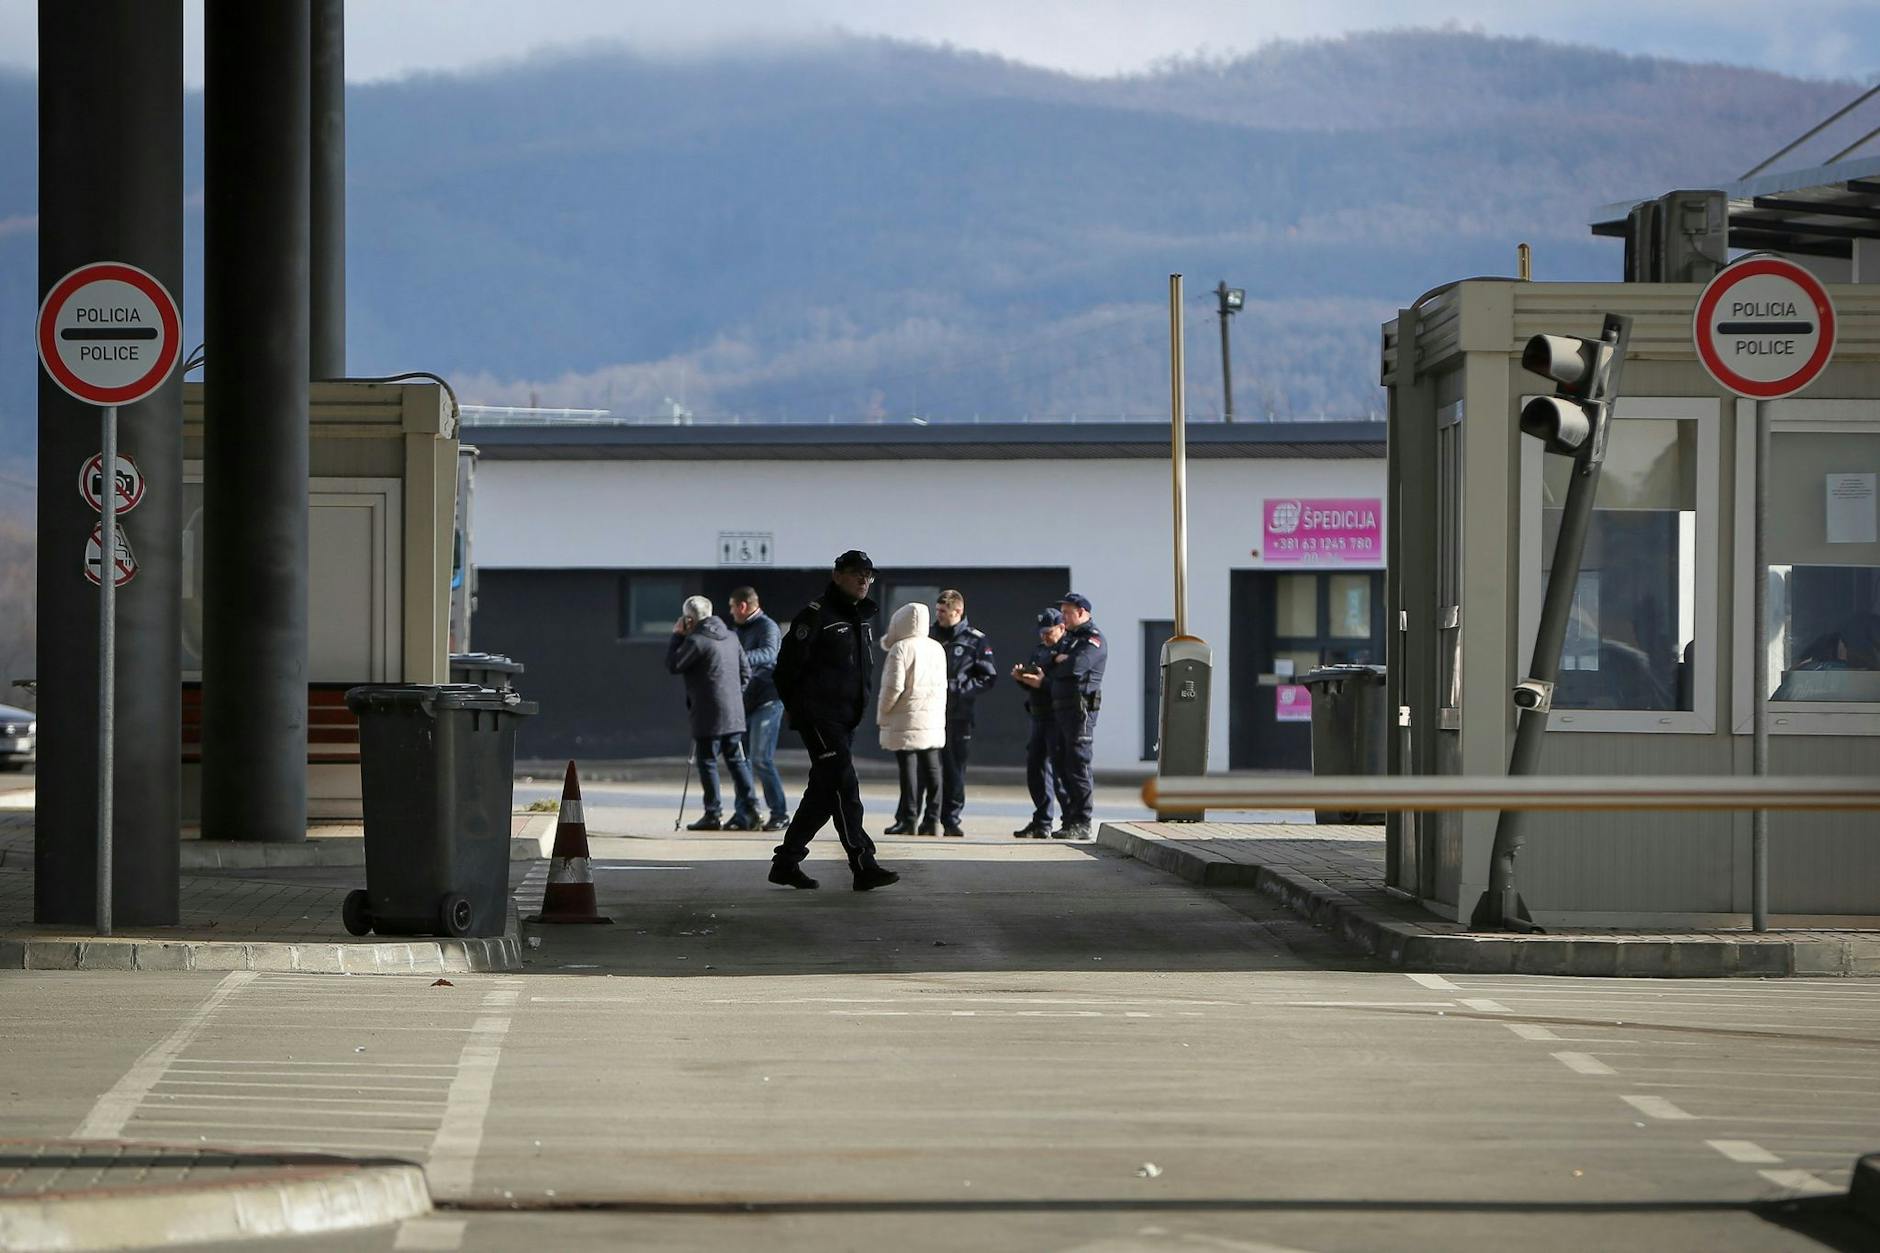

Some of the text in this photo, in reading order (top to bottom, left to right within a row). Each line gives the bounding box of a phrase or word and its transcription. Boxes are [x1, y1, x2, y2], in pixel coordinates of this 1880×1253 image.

[76, 307, 142, 323] POLICIA
[1732, 302, 1798, 318] POLICIA
[79, 346, 140, 361] POLICE
[1735, 340, 1796, 356] POLICE
[1303, 506, 1377, 530] ŠPEDICIJA
